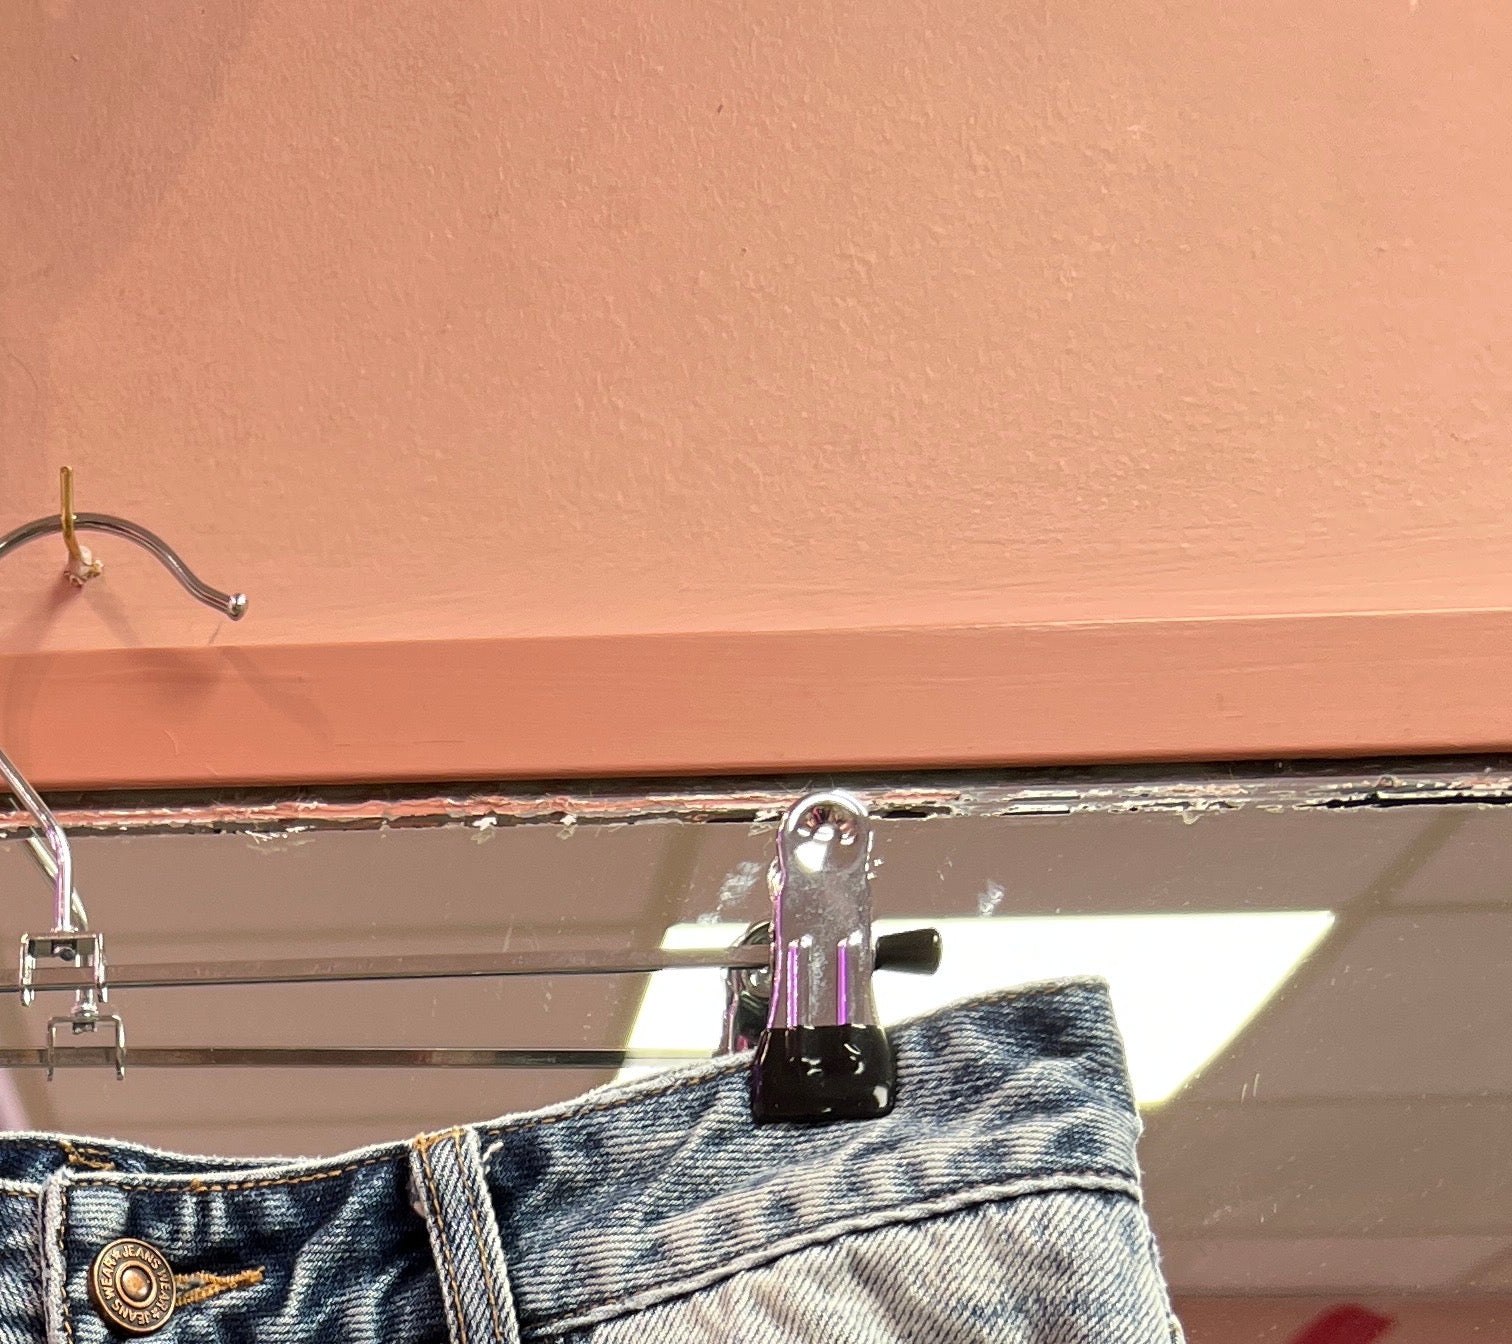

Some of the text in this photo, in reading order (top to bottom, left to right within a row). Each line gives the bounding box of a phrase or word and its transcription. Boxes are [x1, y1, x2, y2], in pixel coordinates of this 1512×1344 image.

[100, 1256, 151, 1325] JEANS WEAR
[122, 1244, 171, 1312] JEANS WEAR
